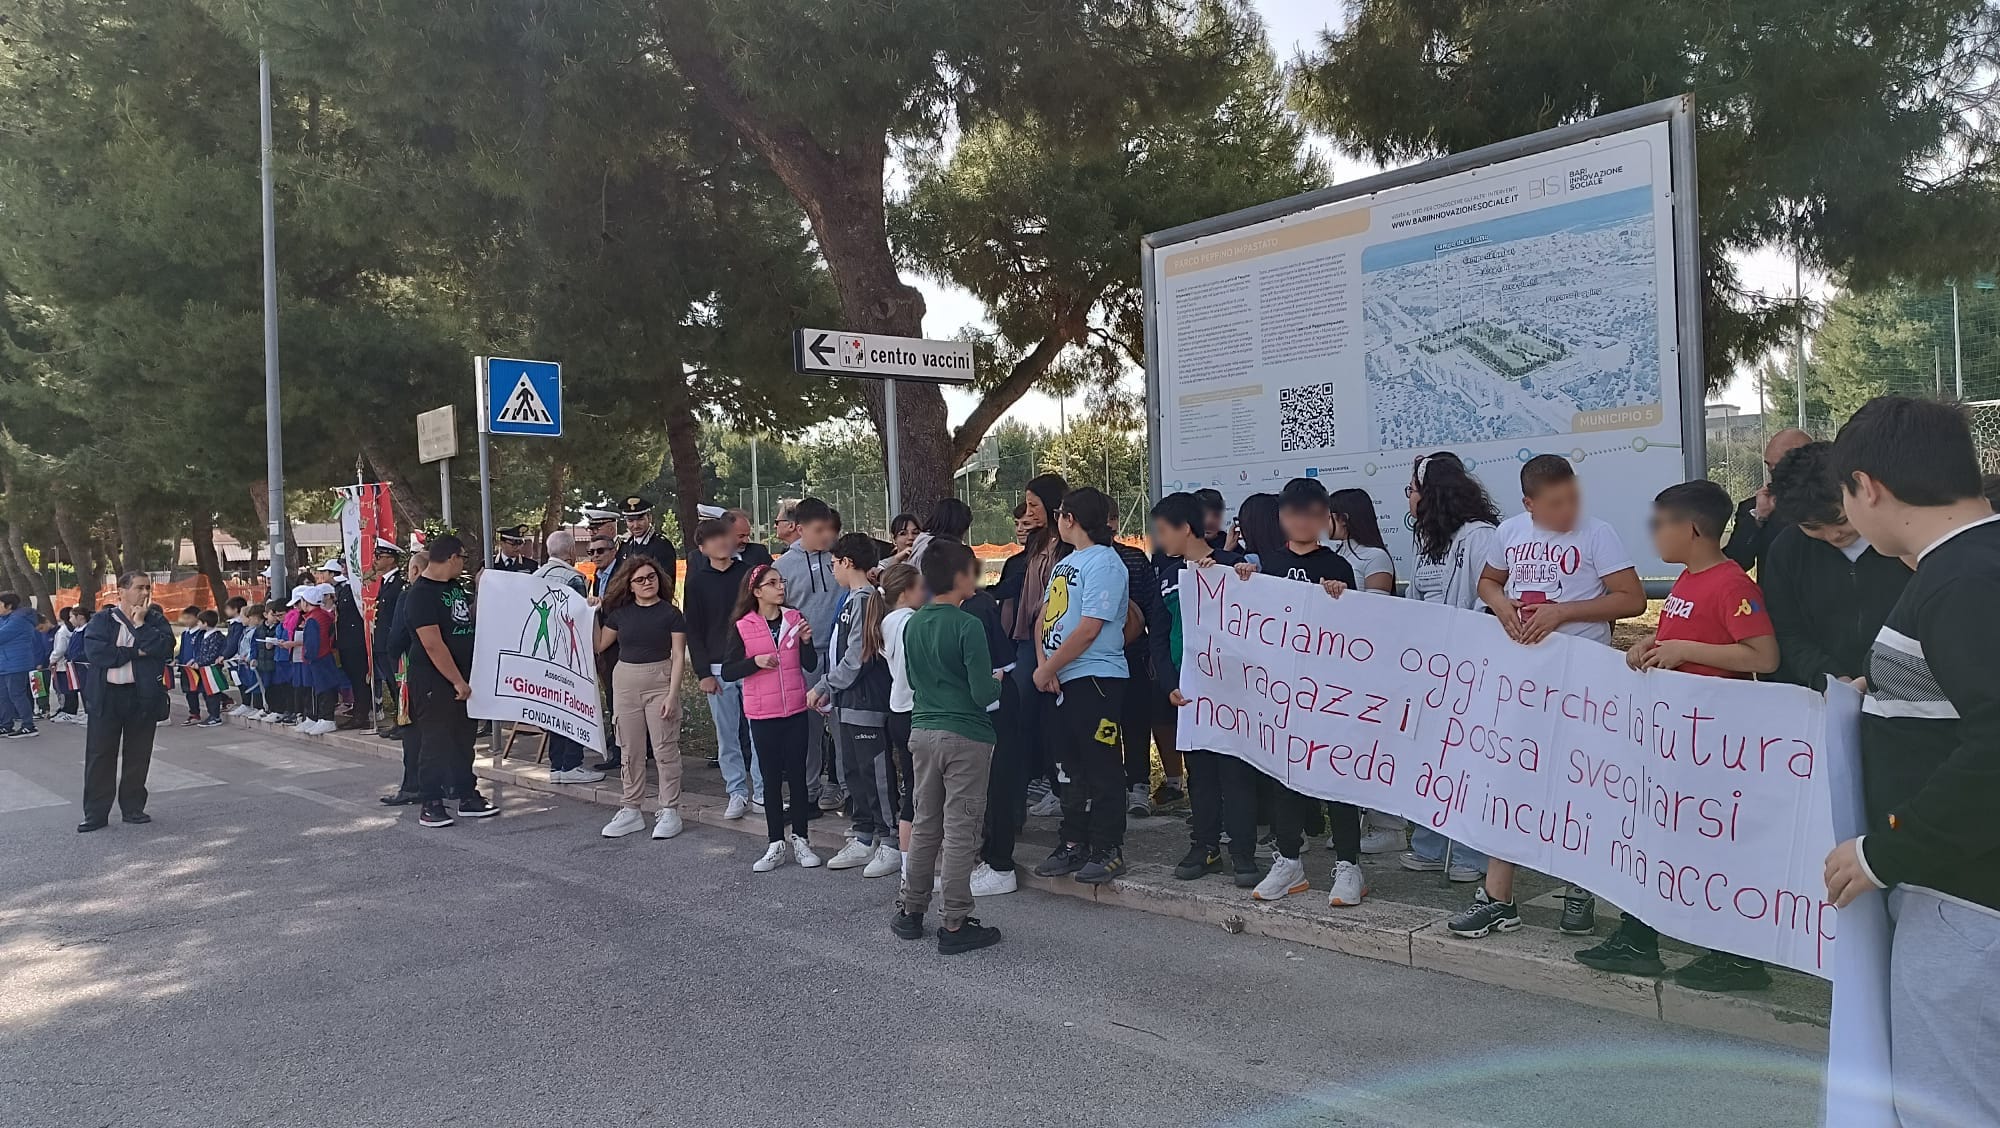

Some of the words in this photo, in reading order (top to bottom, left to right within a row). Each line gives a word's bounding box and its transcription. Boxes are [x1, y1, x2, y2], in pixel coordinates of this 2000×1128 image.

[1569, 167, 1587, 178] BARI
[1569, 166, 1623, 184] INNOVAZIONE
[1569, 178, 1603, 191] SOCIALE
[1528, 175, 1561, 201] BIS
[1391, 194, 1519, 229] WWW.BARIINNOVAZIONESOCIALE.IT
[1174, 256, 1200, 269] PARCO
[1201, 248, 1233, 264] PEPPINO
[1234, 238, 1279, 257] IMPASTATO
[870, 347, 917, 366] centro
[922, 352, 970, 369] vaccini
[1580, 411, 1642, 427] MUNICIPIO
[1645, 409, 1654, 420] 5
[1505, 541, 1581, 576] CHICAGO
[1515, 563, 1558, 583] BULLS
[1663, 593, 1695, 619] appa
[544, 669, 575, 689] Associazione
[1196, 569, 1374, 661] Marciamo
[1400, 648, 1489, 715] oggi
[1627, 694, 1644, 747] la
[1652, 701, 1814, 779] futura
[522, 708, 561, 730] FONDATA
[562, 721, 575, 735] NEL
[576, 727, 591, 743] 1995
[1197, 634, 1223, 681] di
[1242, 663, 1412, 732] ragazzi
[1439, 717, 1539, 773] possa
[1567, 748, 1742, 842] svegliarsi
[1196, 696, 1250, 739] non
[1258, 711, 1275, 755] in
[1287, 734, 1395, 787] preda
[1415, 762, 1471, 828] agli
[1481, 782, 1592, 856] incubi
[1610, 840, 1647, 888] ma
[1657, 860, 1839, 969] accomp
